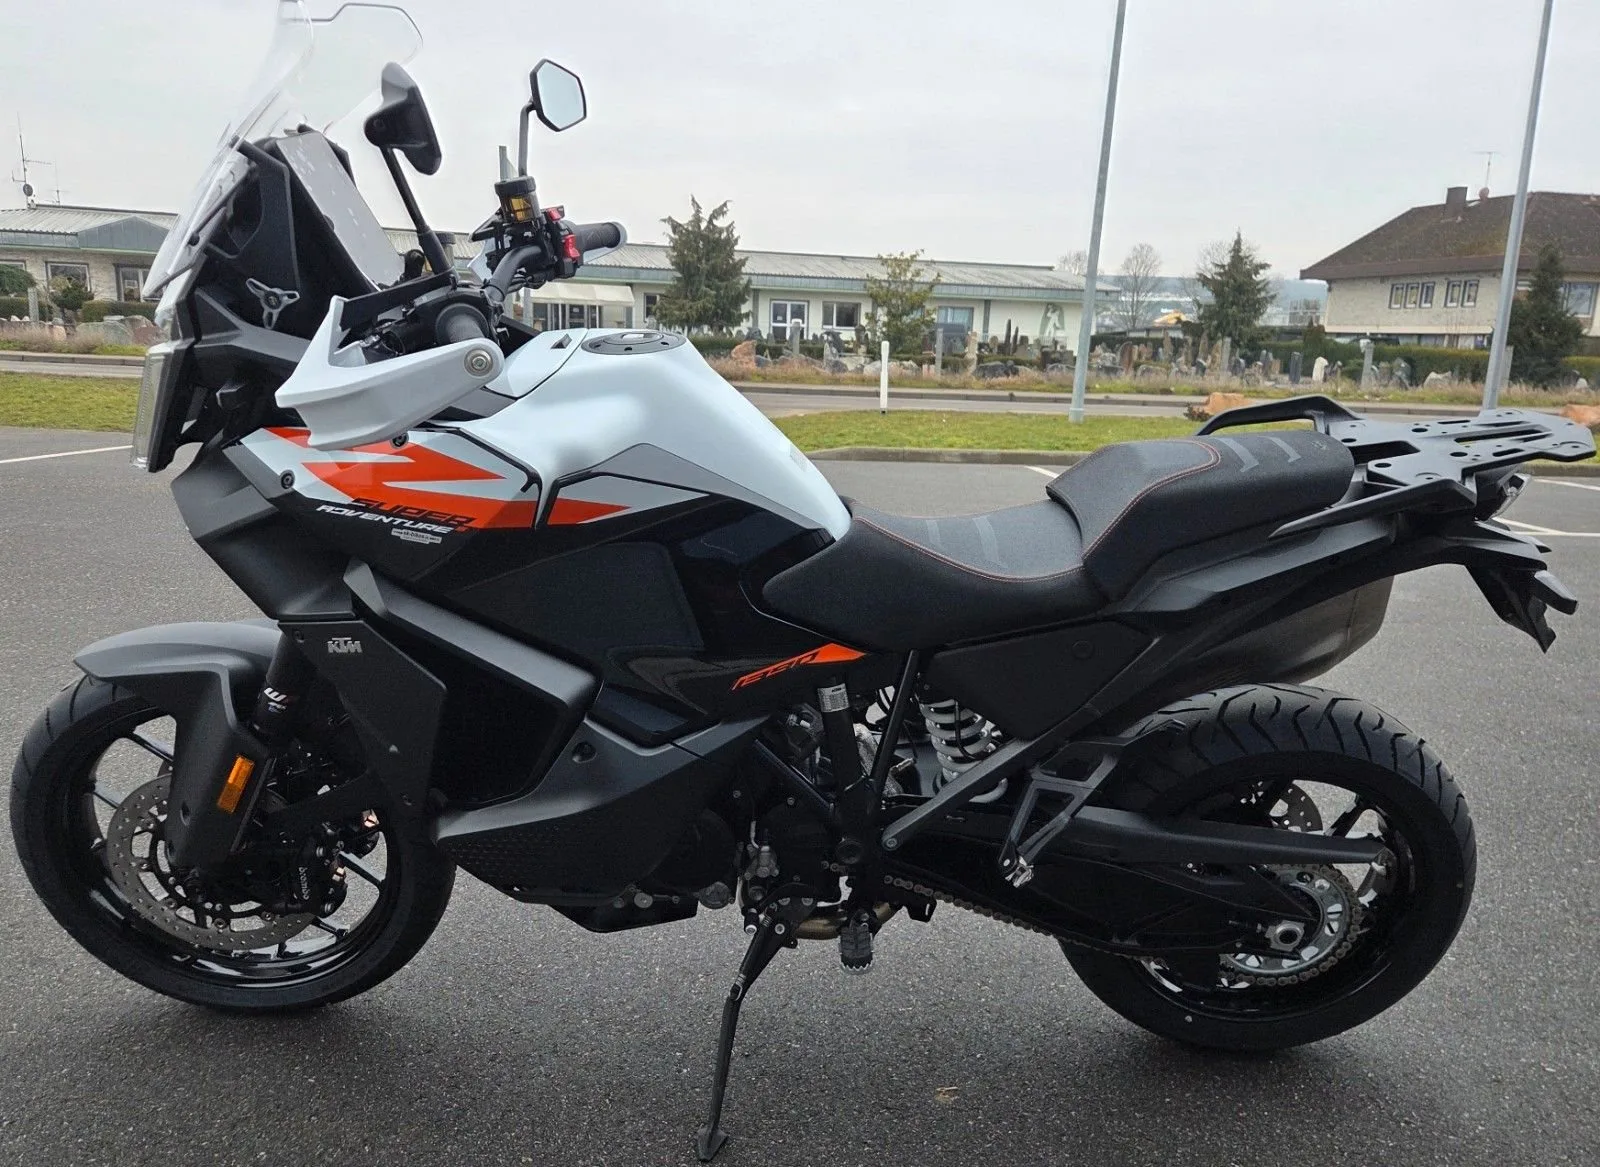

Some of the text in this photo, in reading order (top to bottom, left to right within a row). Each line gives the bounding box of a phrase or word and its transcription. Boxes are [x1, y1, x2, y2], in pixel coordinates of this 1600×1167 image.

[316, 504, 454, 533] ADVENTURE
[349, 498, 477, 525] SUPER
[327, 637, 362, 653] KTM
[298, 867, 310, 900] brembo
